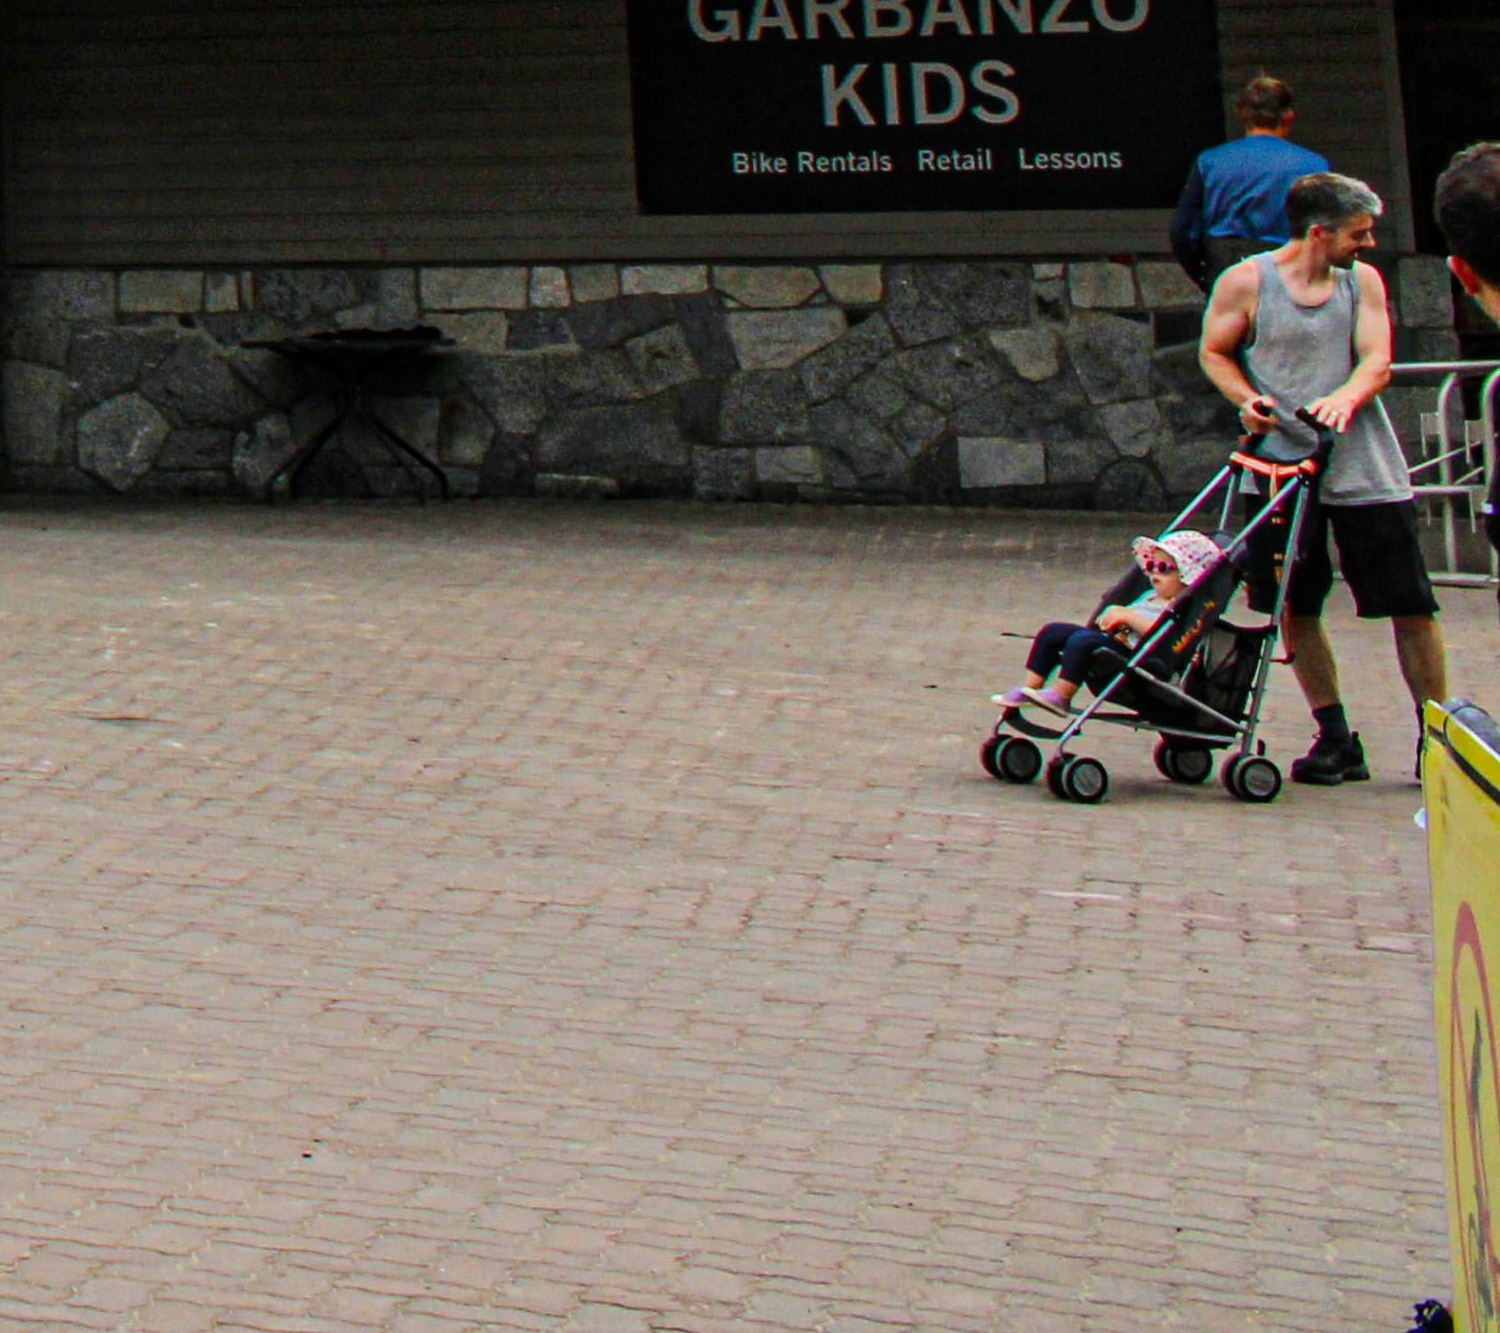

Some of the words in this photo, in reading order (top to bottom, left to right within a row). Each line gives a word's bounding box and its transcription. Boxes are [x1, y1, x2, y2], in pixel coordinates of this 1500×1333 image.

[820, 59, 1021, 128] KIDS
[731, 149, 789, 176] Bike
[796, 149, 893, 175] Rentals
[916, 147, 993, 173] Retail
[1018, 144, 1123, 172] Lessons
